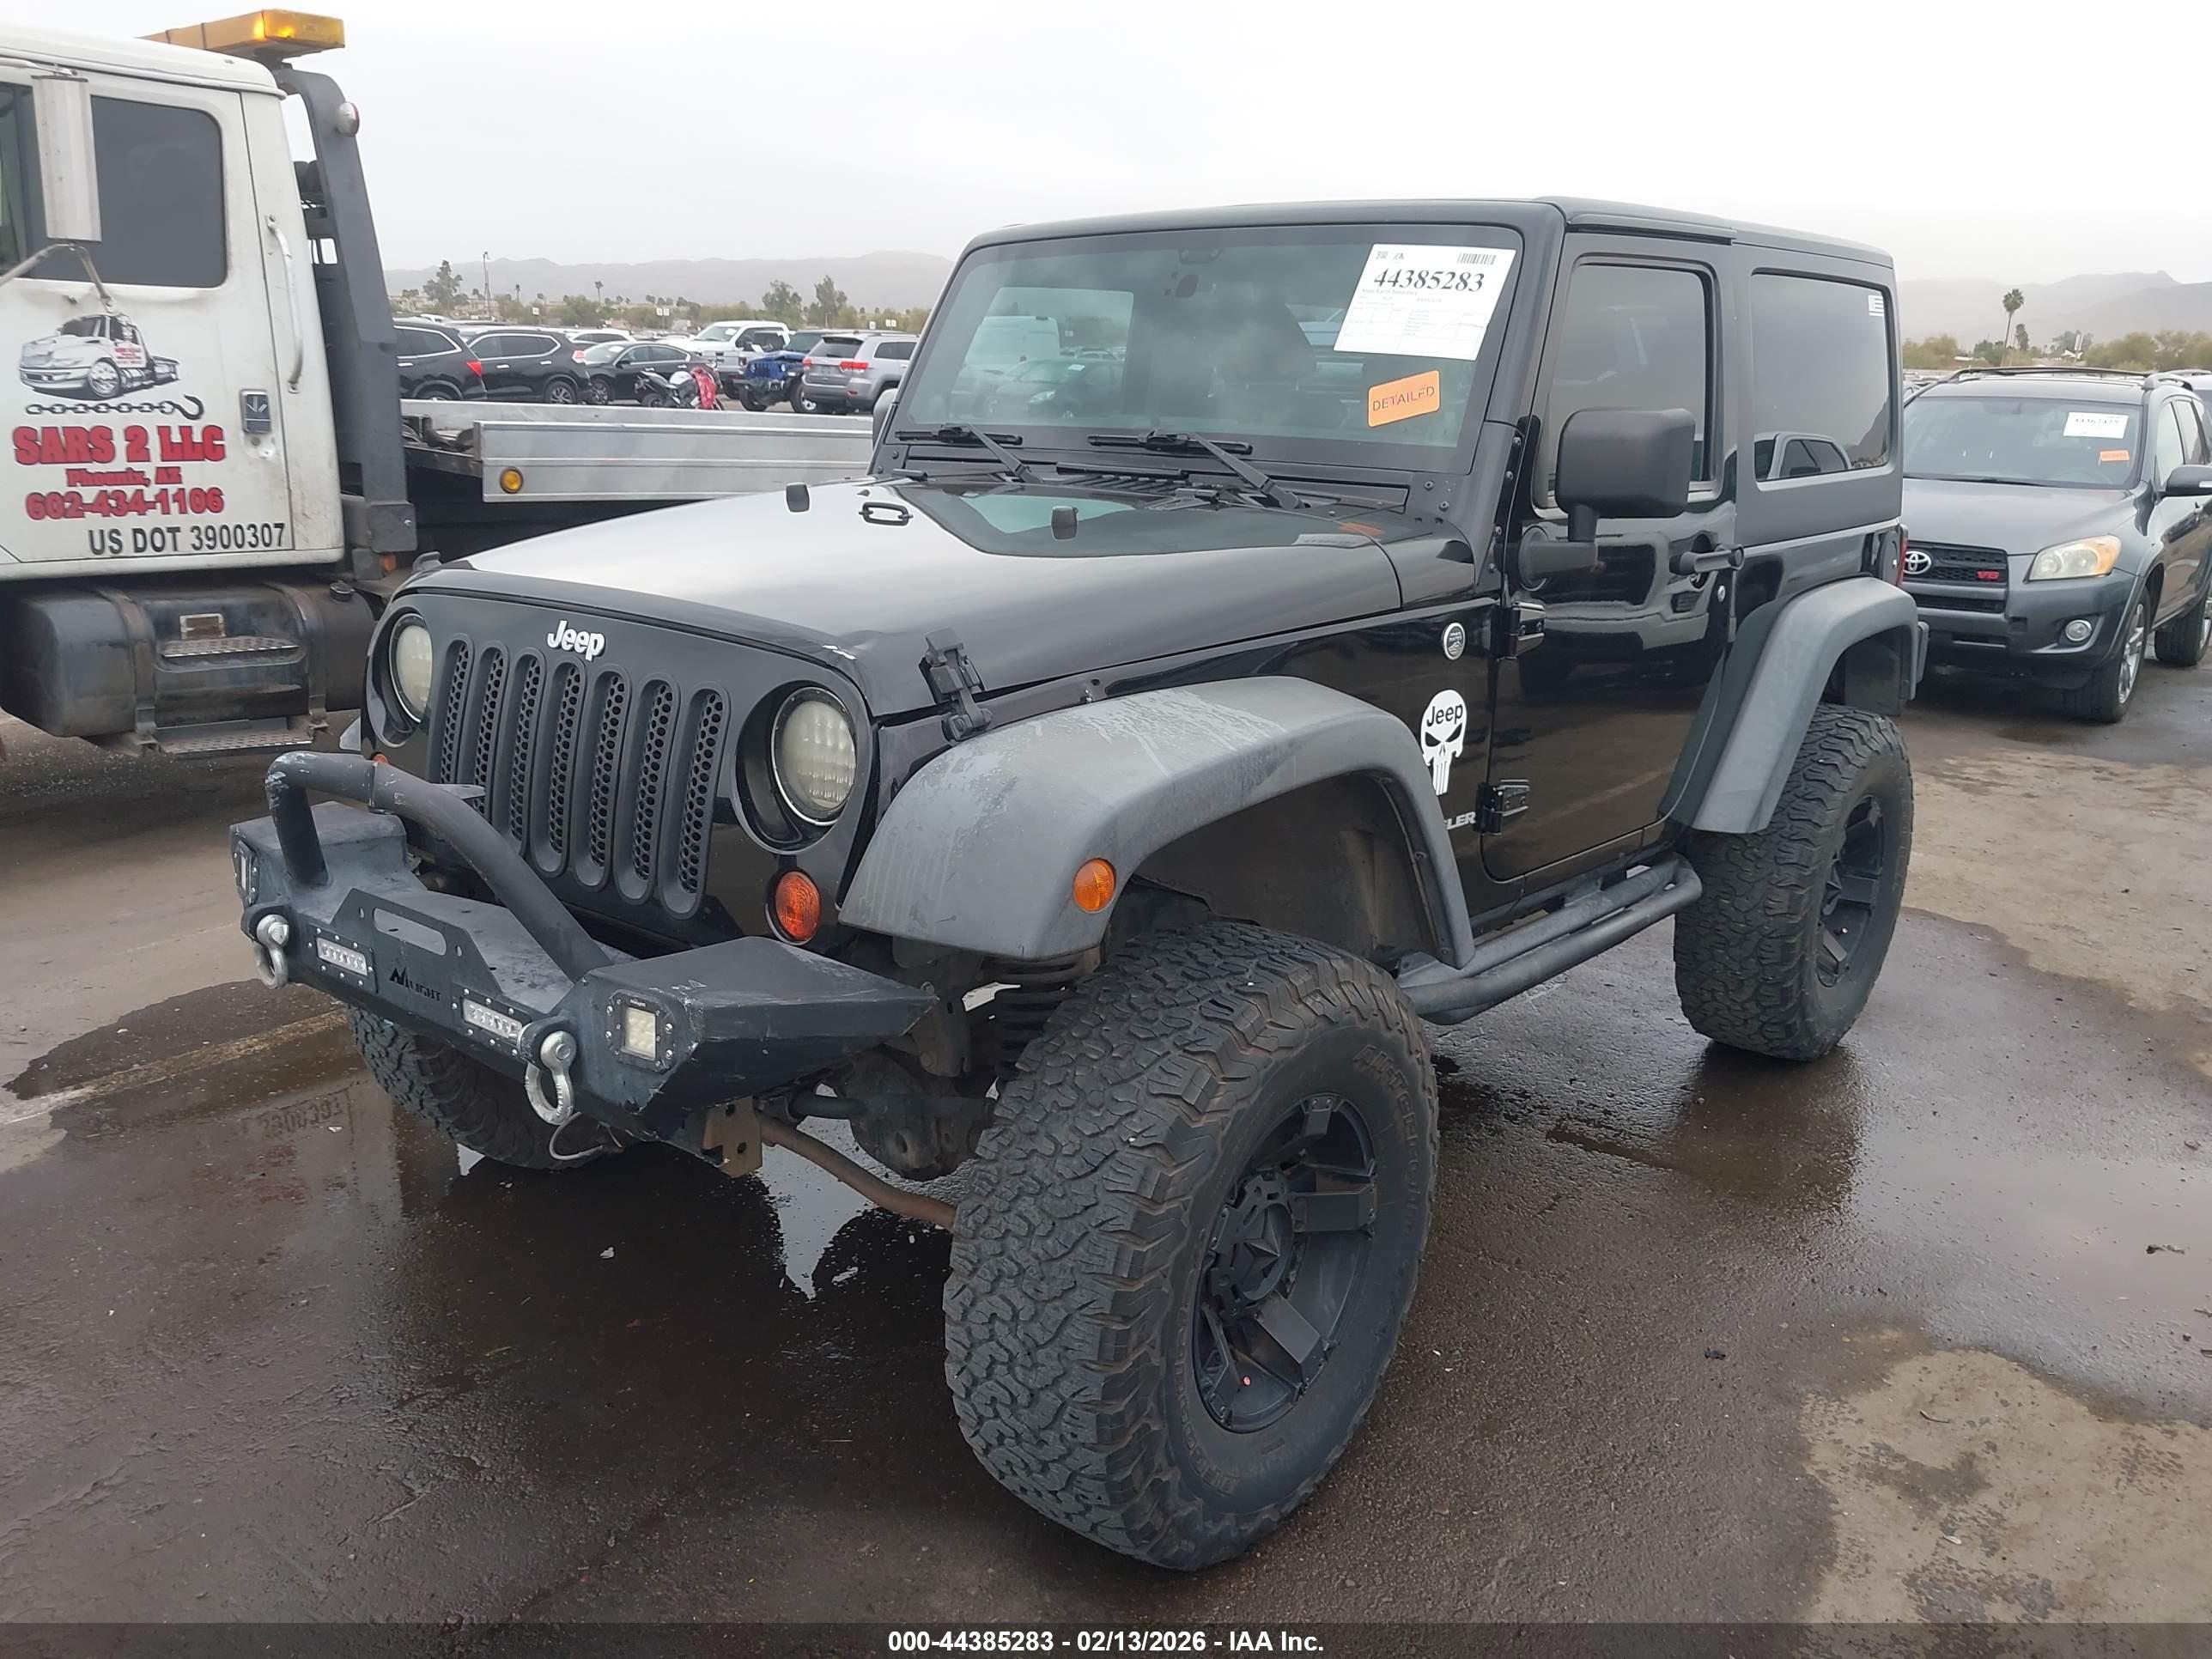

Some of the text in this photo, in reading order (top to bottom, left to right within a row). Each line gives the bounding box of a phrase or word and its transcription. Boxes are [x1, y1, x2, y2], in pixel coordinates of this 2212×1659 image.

[1374, 268, 1485, 293] 44385283
[1373, 386, 1435, 412] DETAILED
[13, 424, 227, 465] SARS 2 LLC
[25, 487, 225, 520] 602-434-1106
[89, 523, 286, 555] US DOT 3900307
[547, 620, 605, 661] Jeep
[1426, 702, 1463, 727] Jeep
